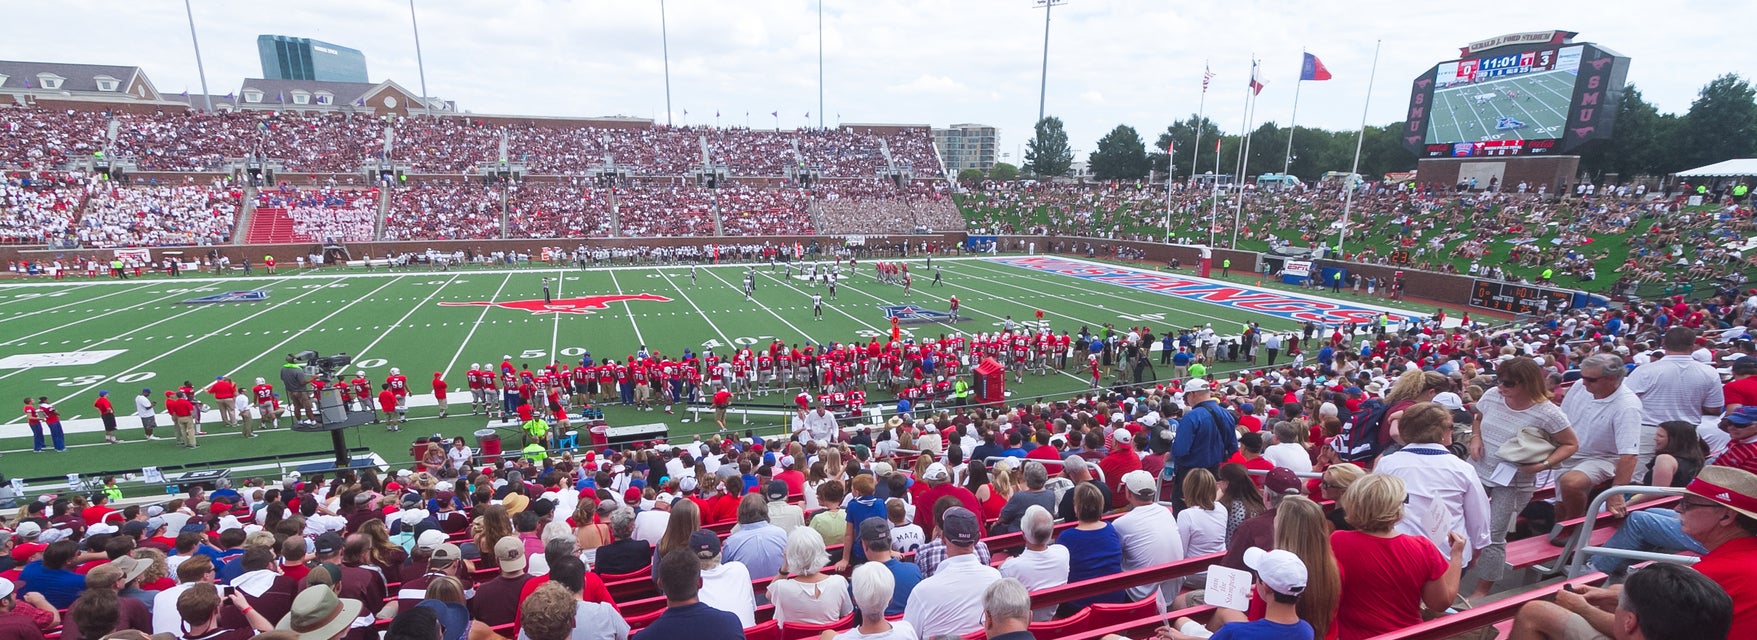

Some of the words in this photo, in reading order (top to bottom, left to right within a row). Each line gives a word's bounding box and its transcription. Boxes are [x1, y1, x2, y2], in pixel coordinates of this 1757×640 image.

[1471, 39, 1495, 50] GERALD
[1503, 35, 1521, 43] FORD
[1522, 32, 1551, 41] STADIUM
[1483, 56, 1516, 69] 11:01
[1540, 55, 1550, 66] 3
[1463, 65, 1472, 75] 0
[1580, 75, 1600, 122] SMU
[1410, 93, 1424, 131] SMU
[1391, 251, 1407, 263] 23
[1287, 263, 1310, 271] ESPN
[520, 347, 587, 359] 50
[57, 372, 157, 387] 30
[258, 389, 271, 398] 32
[896, 531, 919, 543] MATA
[1225, 572, 1236, 605] Stampede
